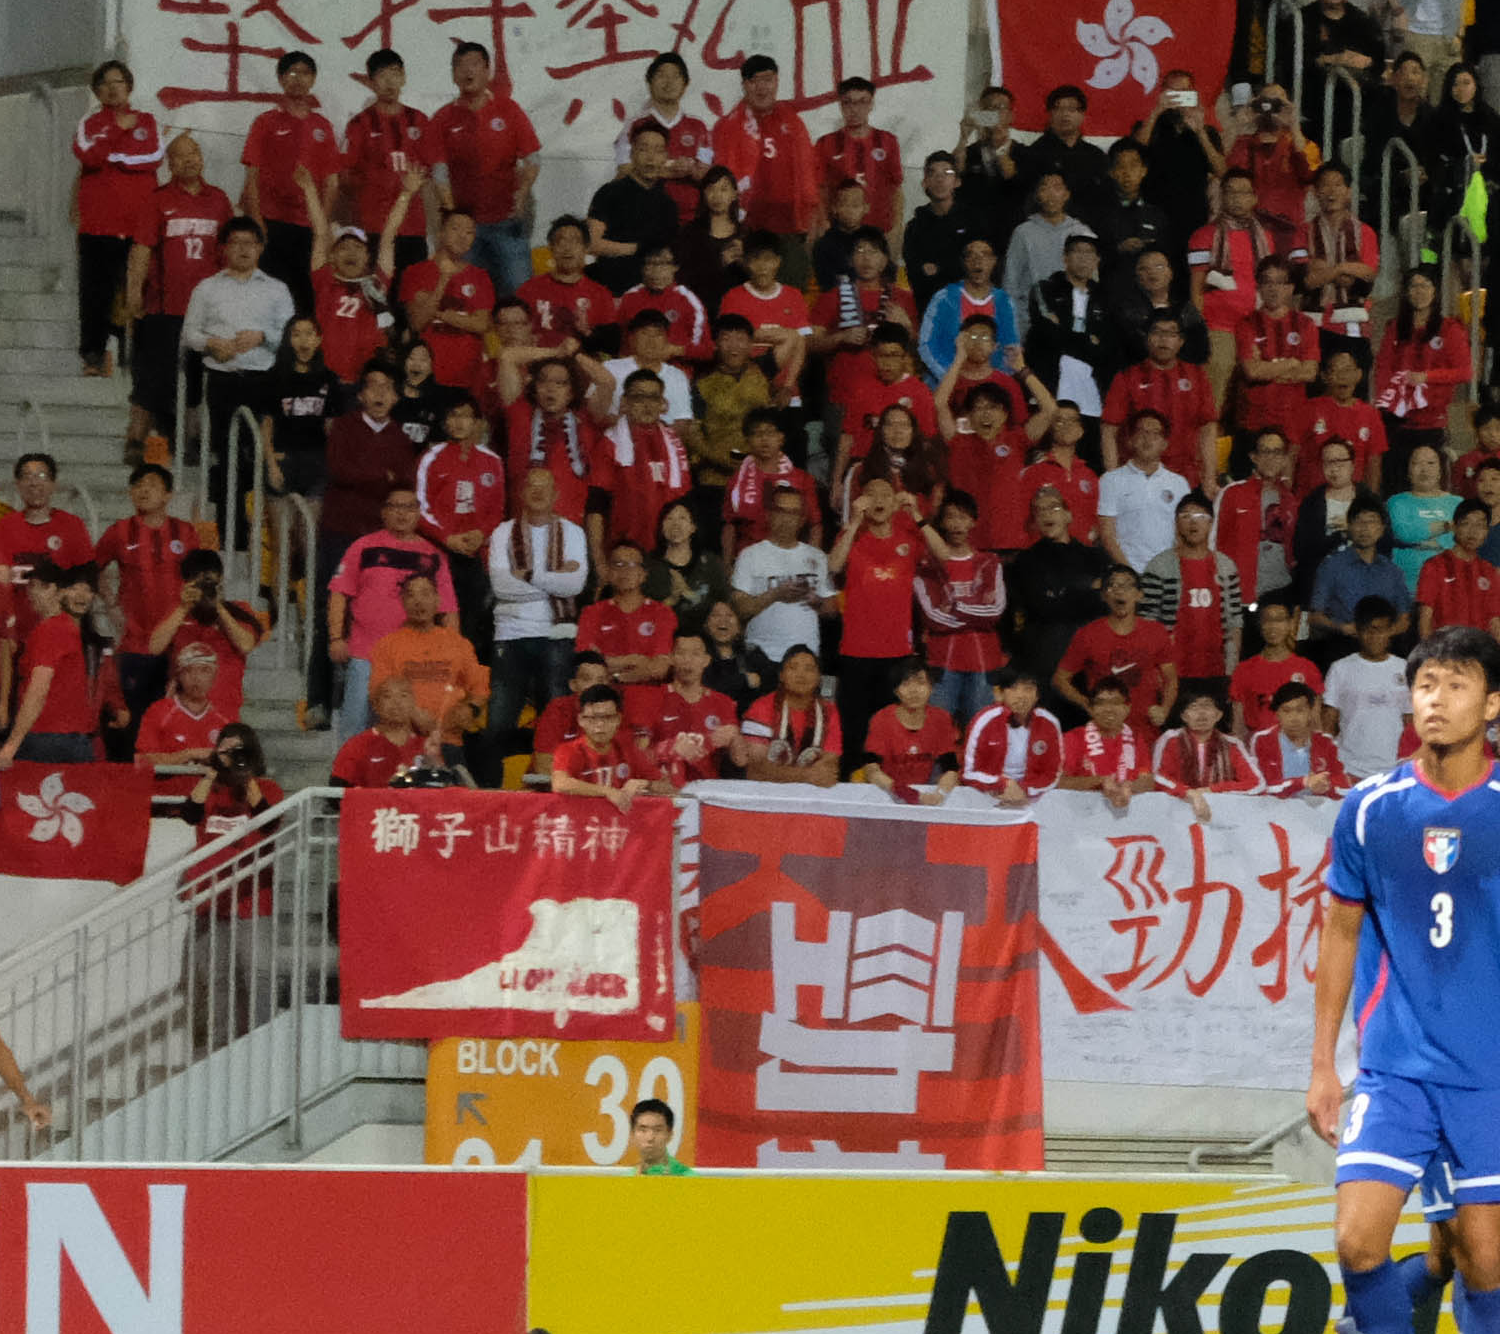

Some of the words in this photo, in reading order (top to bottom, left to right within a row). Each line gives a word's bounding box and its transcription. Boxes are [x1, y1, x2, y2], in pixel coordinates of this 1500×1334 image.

[1187, 587, 1213, 609] 10
[370, 807, 631, 862] 獅子山精神
[1429, 891, 1454, 949] 3
[452, 1039, 559, 1075] BLOCK
[578, 1054, 685, 1166] 30
[1342, 1092, 1371, 1145] 3
